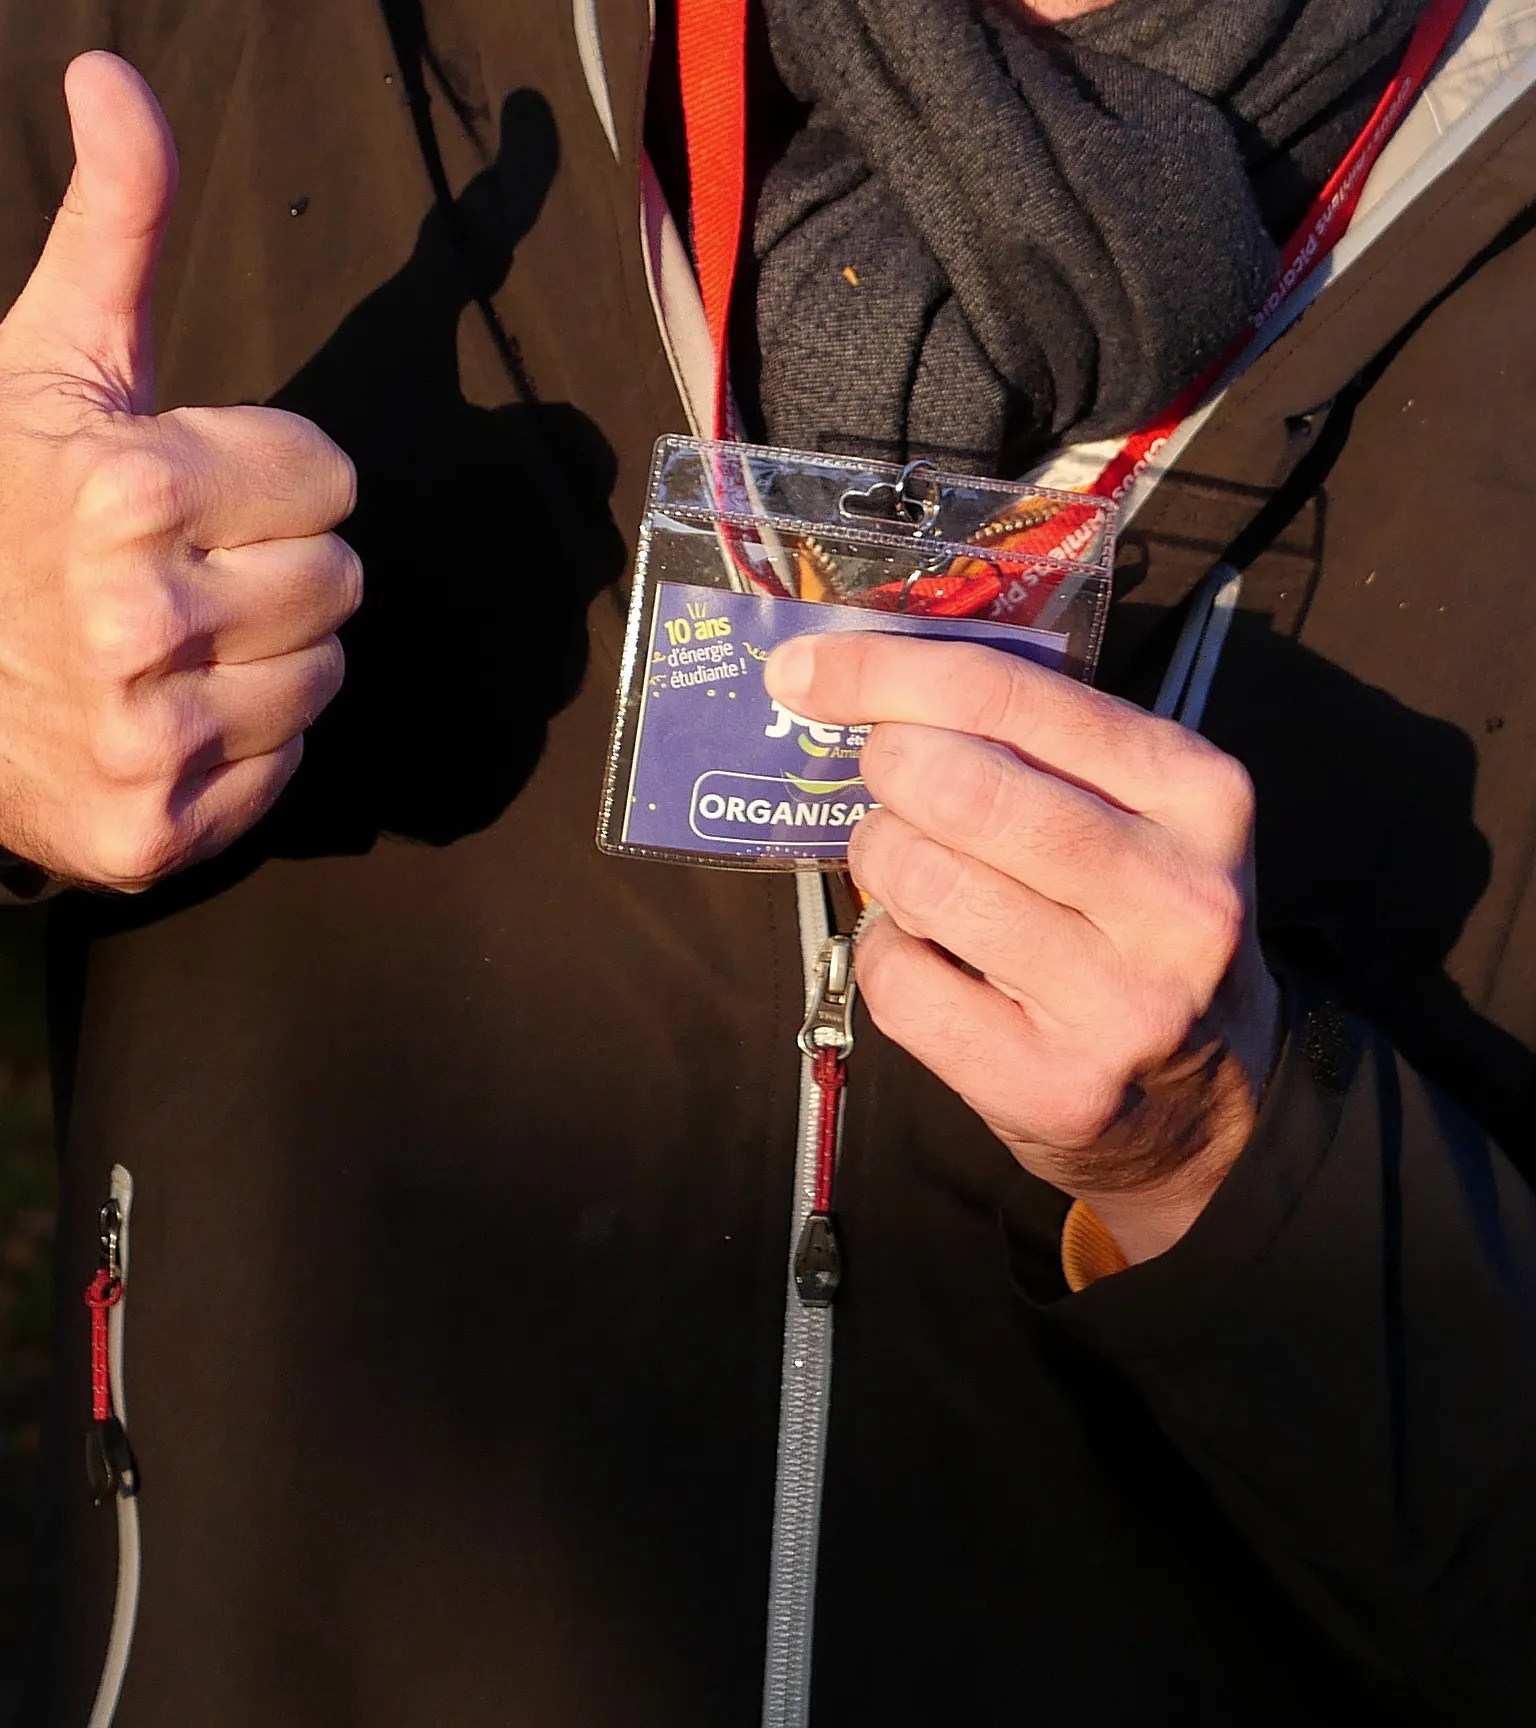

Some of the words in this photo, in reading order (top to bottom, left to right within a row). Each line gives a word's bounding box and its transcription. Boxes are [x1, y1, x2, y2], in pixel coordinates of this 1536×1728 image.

[664, 618, 692, 646] 10
[694, 616, 732, 642] ans
[667, 640, 734, 668] d'énergie
[698, 793, 884, 826] ORGANISA
